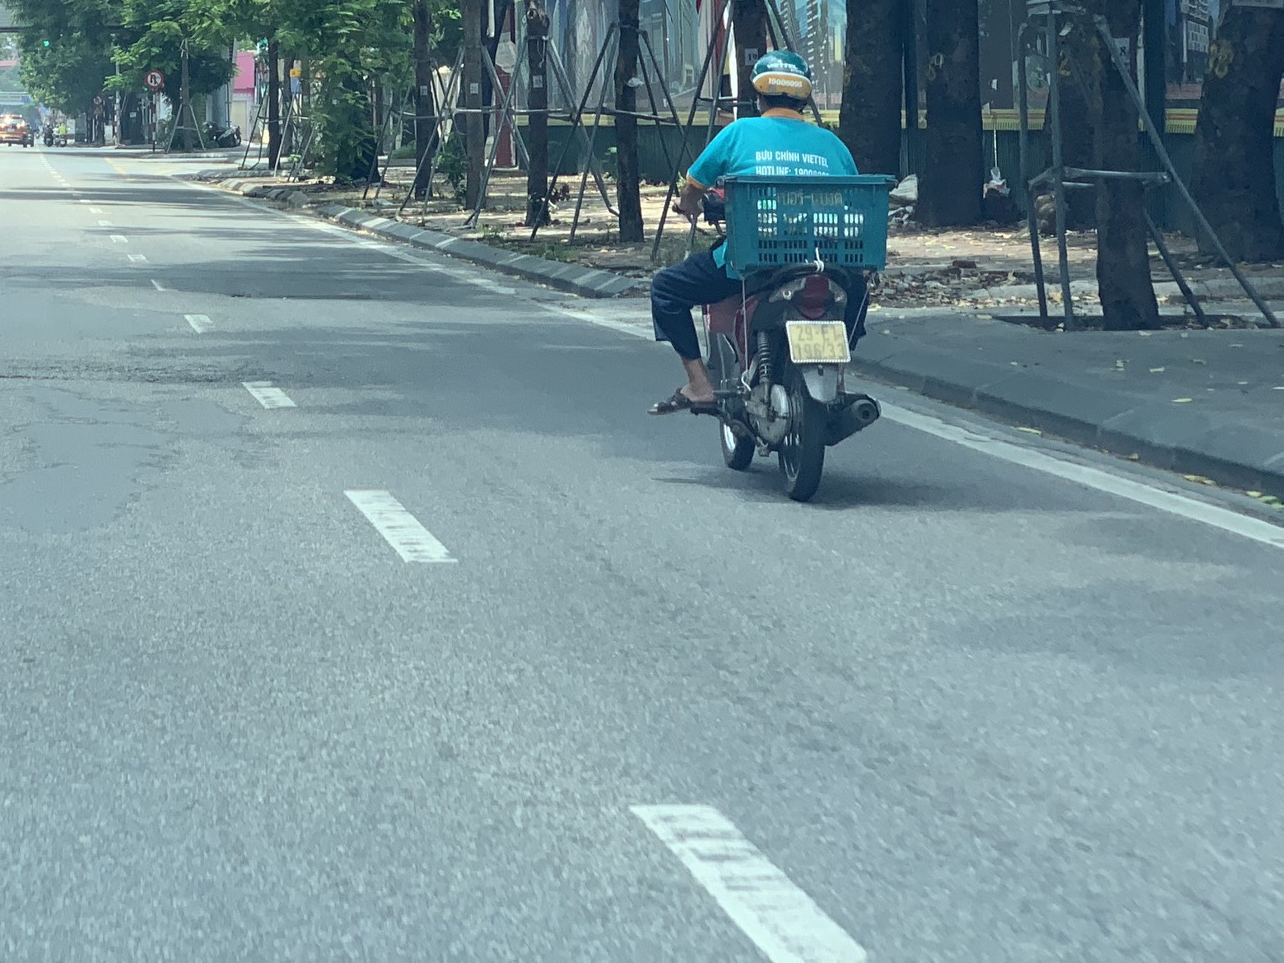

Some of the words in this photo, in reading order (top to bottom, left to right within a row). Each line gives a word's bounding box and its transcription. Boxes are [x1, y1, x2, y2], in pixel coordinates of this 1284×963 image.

[756, 149, 773, 161] BƯU
[775, 150, 800, 163] CHÍNH
[802, 153, 828, 168] VIETTEL
